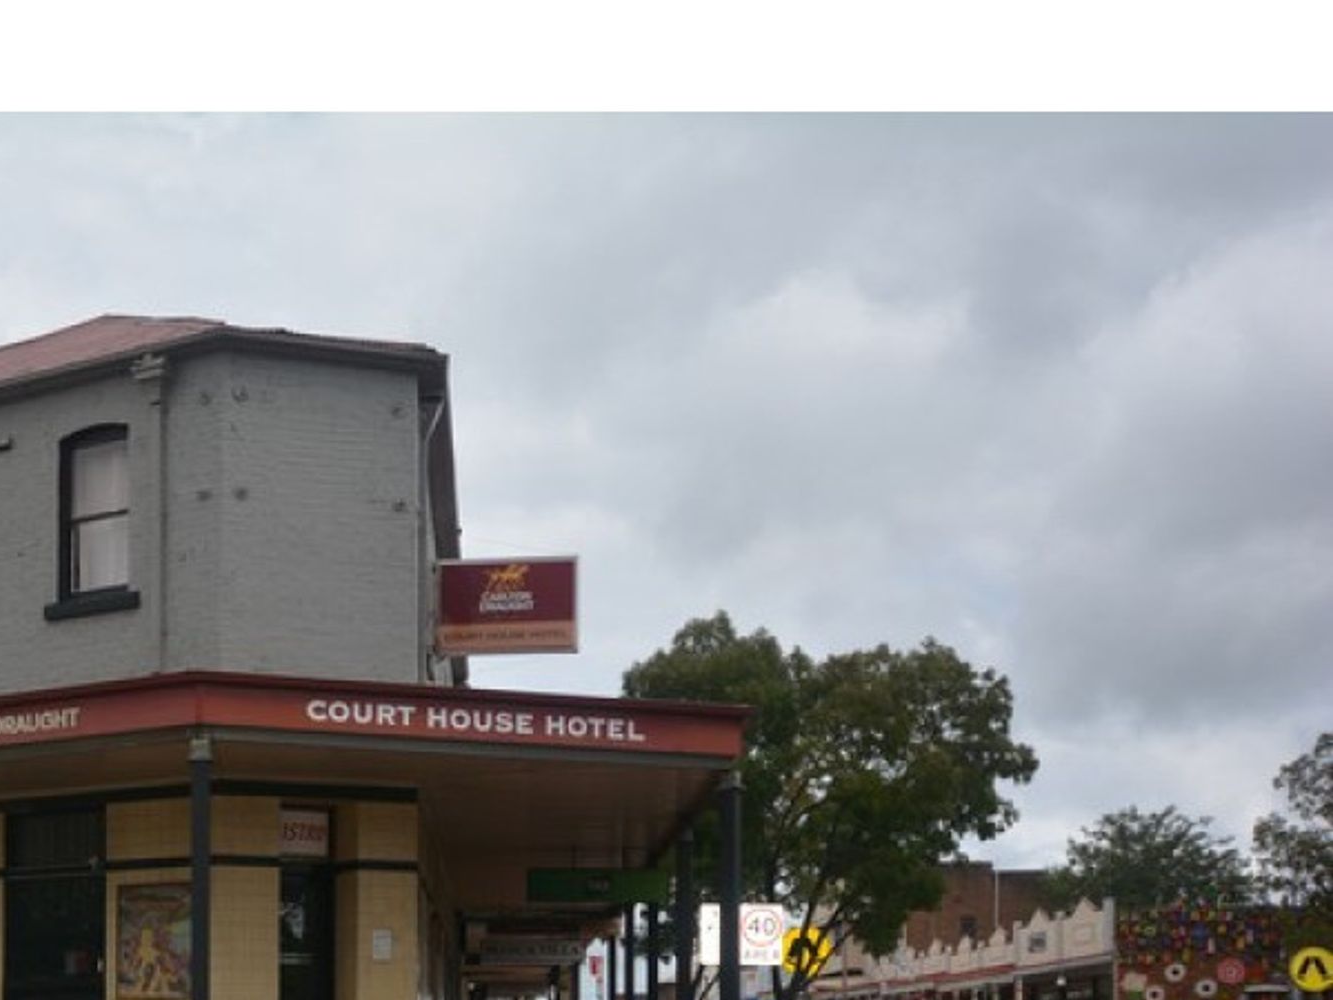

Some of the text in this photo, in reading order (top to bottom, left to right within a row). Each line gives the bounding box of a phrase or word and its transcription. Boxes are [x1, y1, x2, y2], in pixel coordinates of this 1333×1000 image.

[306, 699, 647, 742] COURT HOUSE HOTEL
[747, 916, 777, 937] 40
